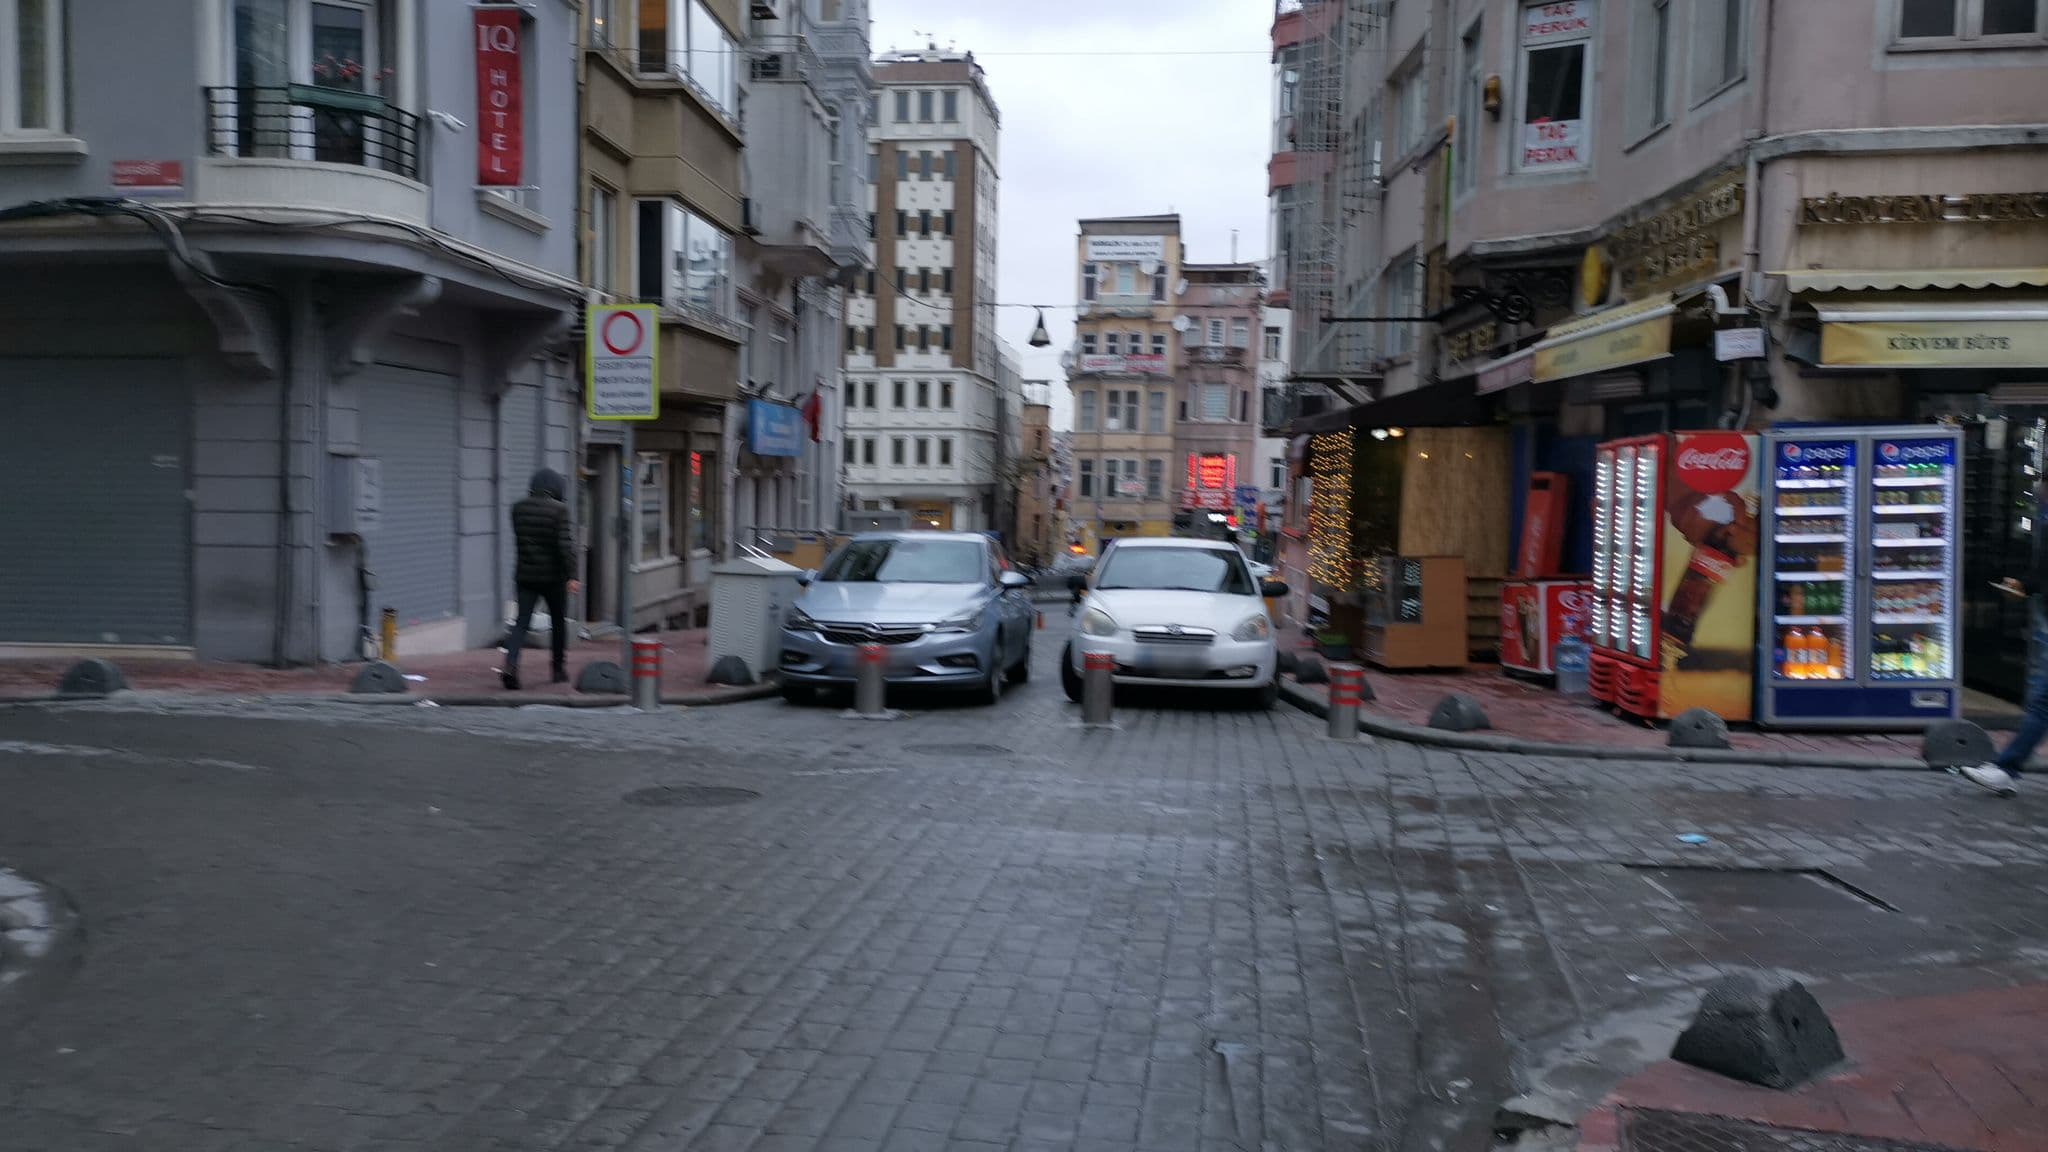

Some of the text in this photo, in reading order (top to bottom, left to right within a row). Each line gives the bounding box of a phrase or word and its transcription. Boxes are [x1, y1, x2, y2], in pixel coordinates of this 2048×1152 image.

[477, 24, 516, 54] IQ
[490, 69, 508, 173] HOTEL
[1803, 445, 1849, 462] pepsi
